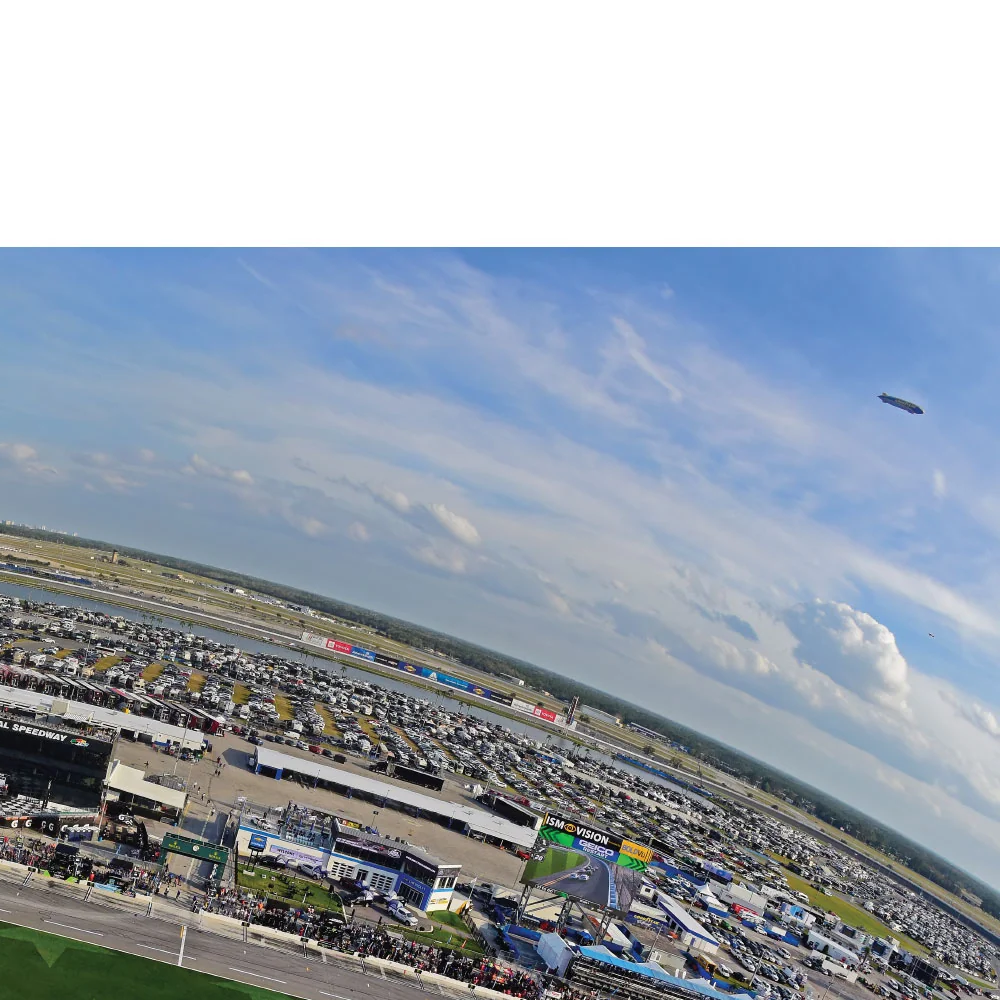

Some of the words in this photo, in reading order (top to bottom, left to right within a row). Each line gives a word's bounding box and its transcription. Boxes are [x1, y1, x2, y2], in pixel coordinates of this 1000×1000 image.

[12, 723, 67, 742] SPEEDWAY
[546, 816, 564, 829] ISM
[576, 827, 609, 845] VISION
[579, 840, 614, 856] GEICO
